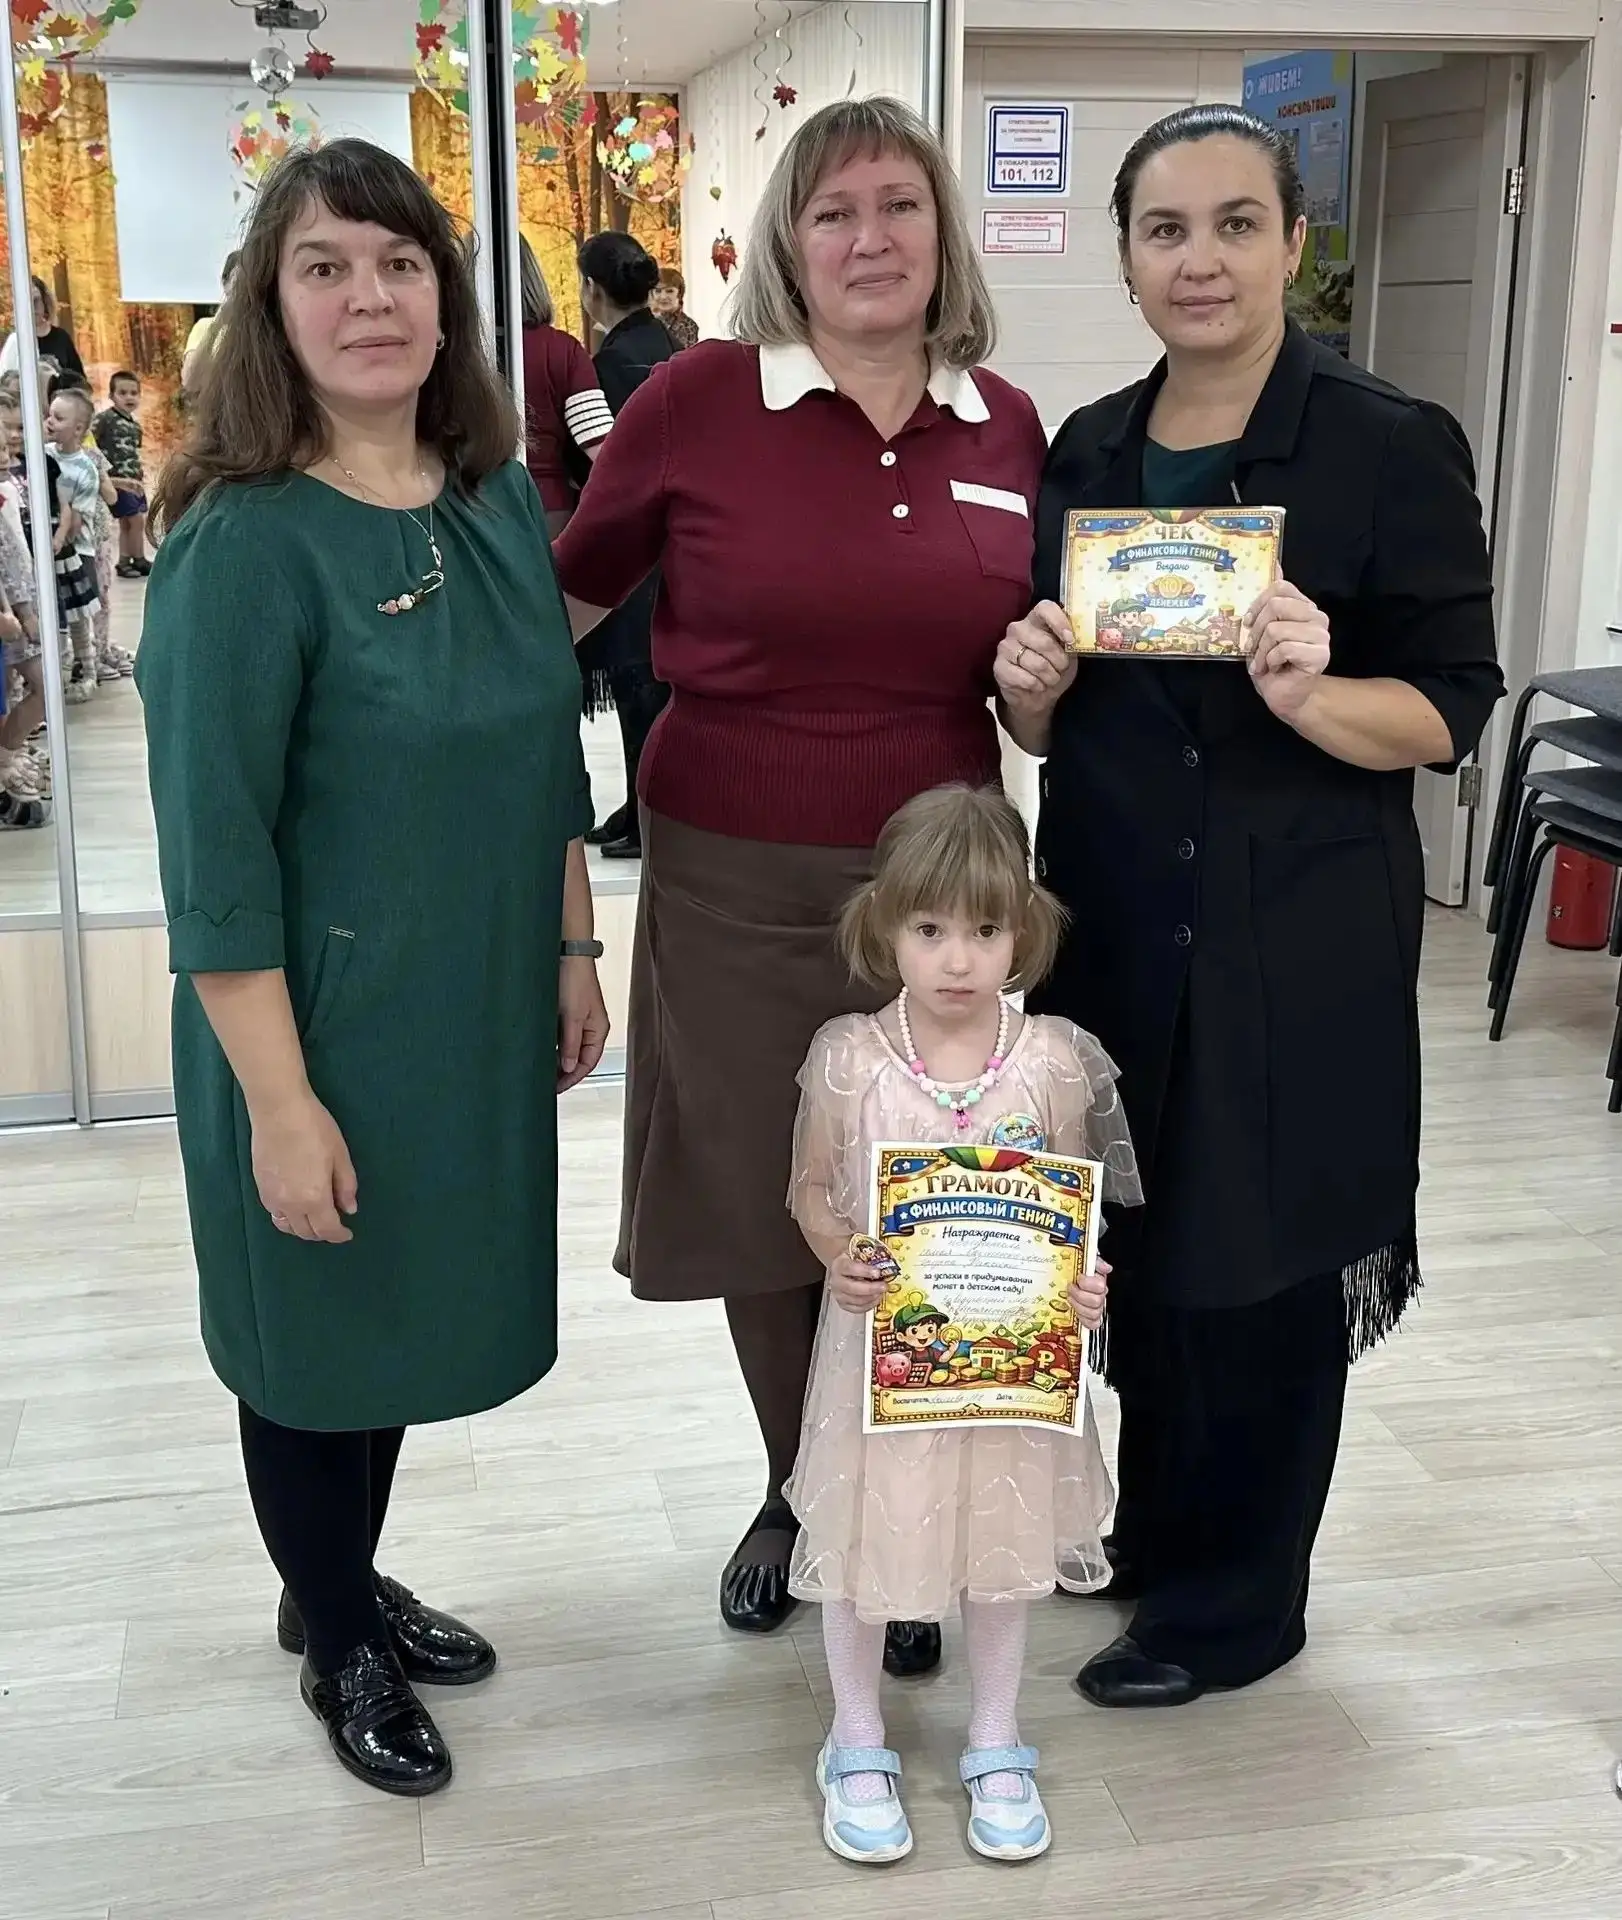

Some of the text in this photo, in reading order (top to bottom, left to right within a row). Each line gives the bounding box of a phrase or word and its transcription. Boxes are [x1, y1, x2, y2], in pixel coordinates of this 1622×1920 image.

[1000, 168, 1053, 183] 101, 112
[1154, 526, 1194, 540] ЧЕК
[1127, 545, 1218, 560] ФИНАНСОВЫЙ ГЕНИЙ
[1156, 561, 1190, 573] Выдано
[1150, 598, 1190, 608] ДЕНЕЖЕК
[926, 1174, 1042, 1201] ГРАМОТА
[909, 1200, 1057, 1228] ФИНАНСОВЫЙ ГЕНИЙ
[942, 1225, 1021, 1241] Награждается
[934, 1273, 962, 1281] успехи
[971, 1273, 1033, 1284] придумывании
[967, 1283, 1001, 1291] детском
[1002, 1285, 1024, 1295] саду!
